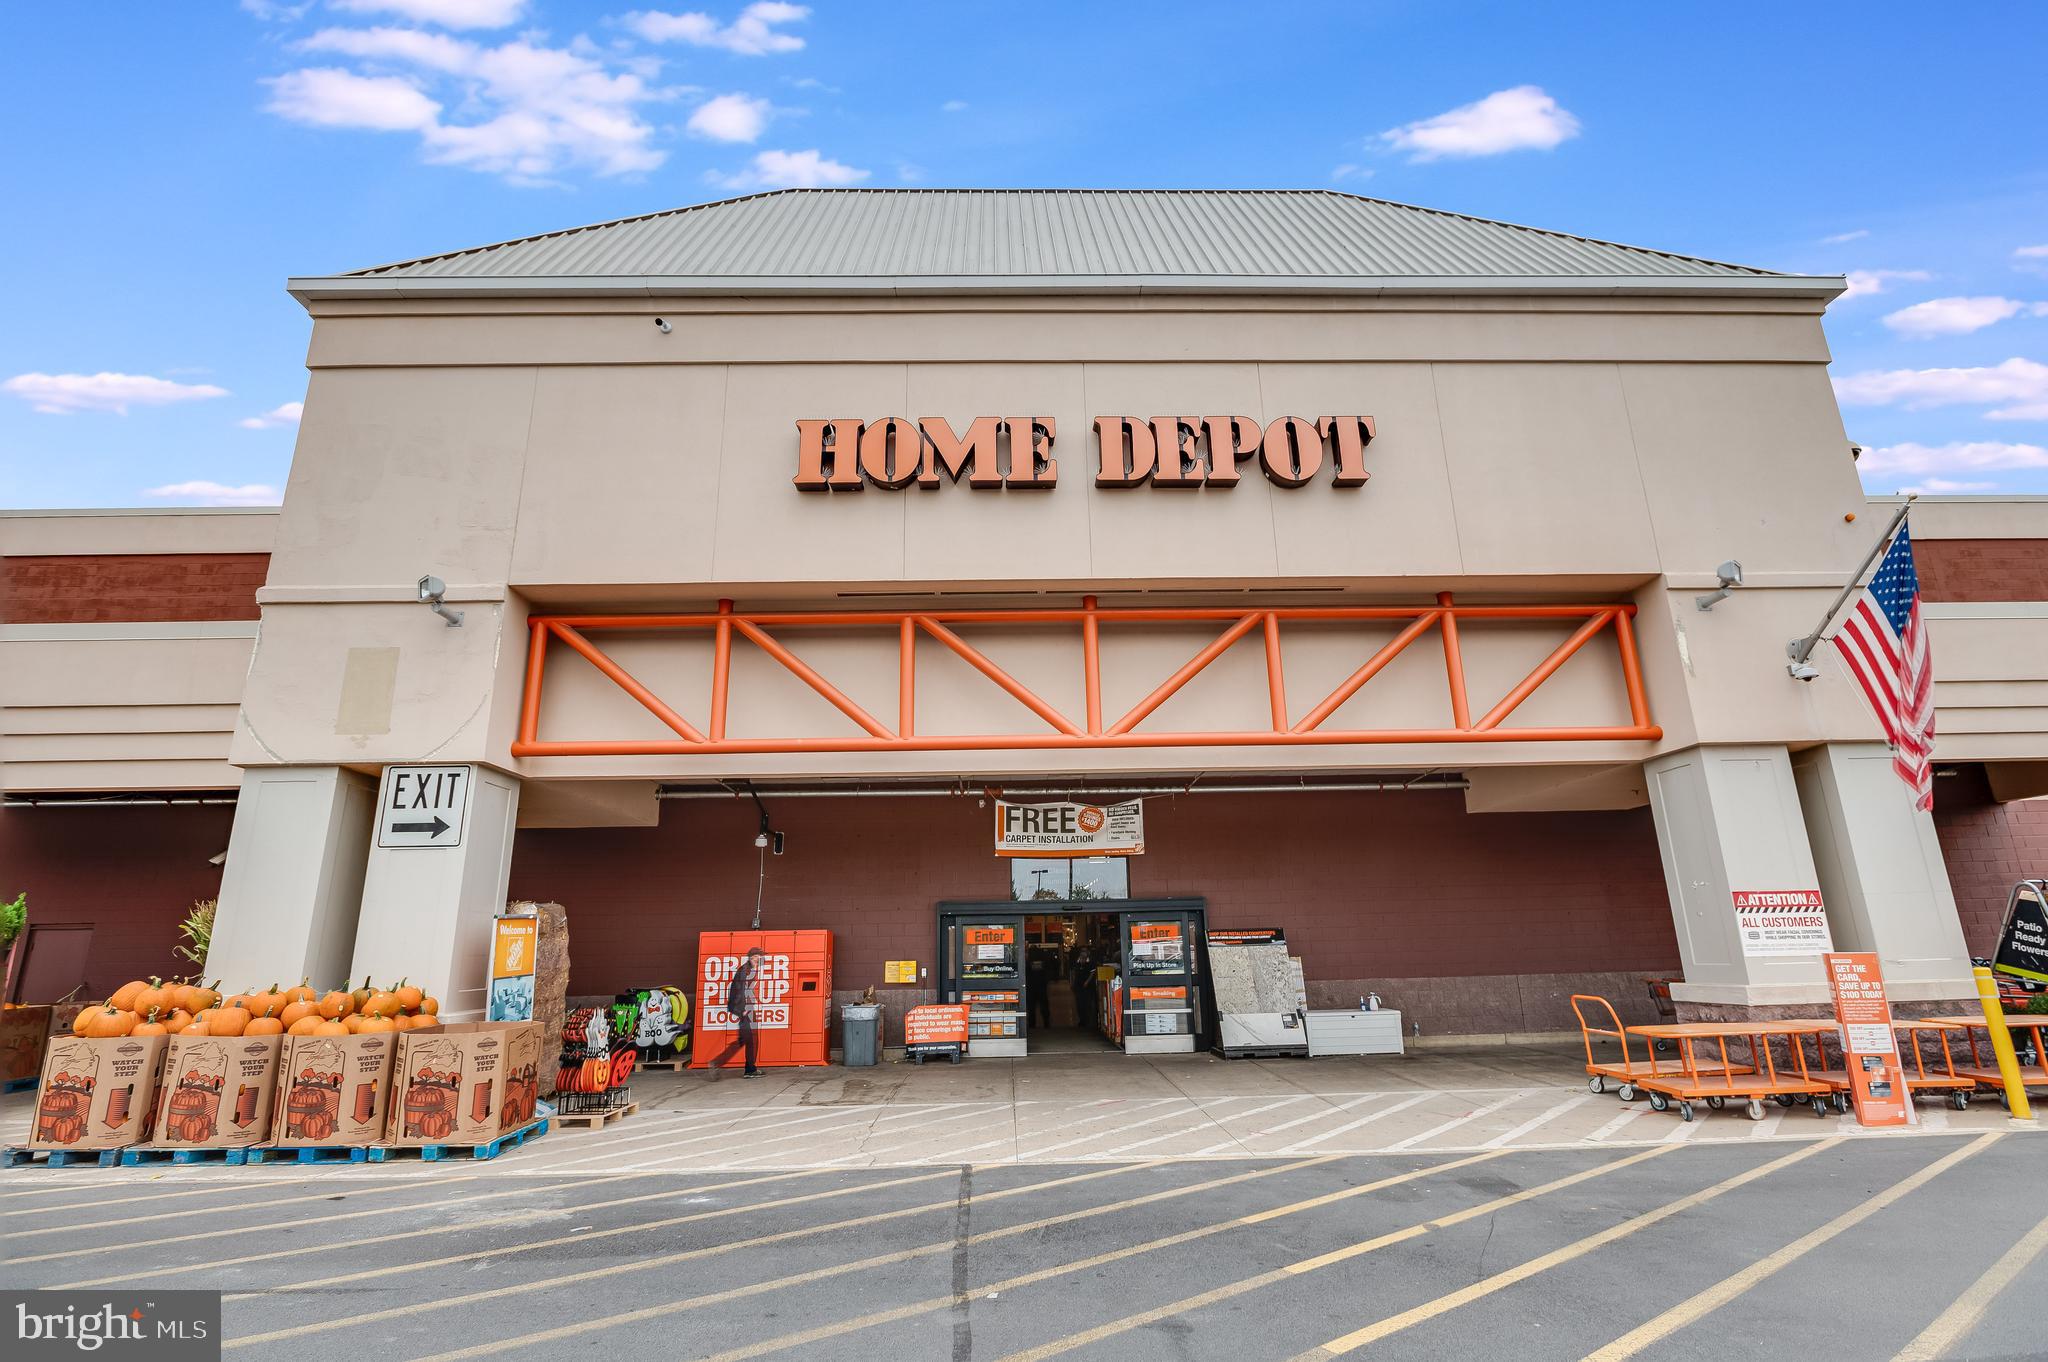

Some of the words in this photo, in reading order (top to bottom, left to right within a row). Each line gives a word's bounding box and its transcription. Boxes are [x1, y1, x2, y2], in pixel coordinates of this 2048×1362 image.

[792, 416, 1057, 491] HOME
[1093, 415, 1376, 489] DEPOT
[392, 773, 460, 809] EXIT
[1005, 806, 1076, 833] FREE
[1006, 835, 1037, 844] CARPET
[1038, 835, 1094, 844] INSTALLATION
[1748, 893, 1808, 906] ATTENTION
[1742, 917, 1760, 928] ALL
[1761, 916, 1824, 928] CUSTOMERS
[2017, 920, 2042, 932] Patio
[500, 924, 526, 935] Welcome
[527, 926, 533, 934] to
[1140, 927, 1170, 939] Enter
[975, 931, 1005, 942] Enter
[2015, 931, 2046, 946] Ready
[1835, 965, 1850, 973] GET
[1852, 965, 1867, 973] THE
[1837, 973, 1861, 982] CARD,
[1839, 982, 1859, 990] SAVE
[703, 980, 790, 1005] PIKUP
[1841, 990, 1859, 999] $100
[707, 1009, 785, 1024] LOCERS
[644, 1029, 662, 1038] BOO
[474, 1053, 499, 1061] WATCH
